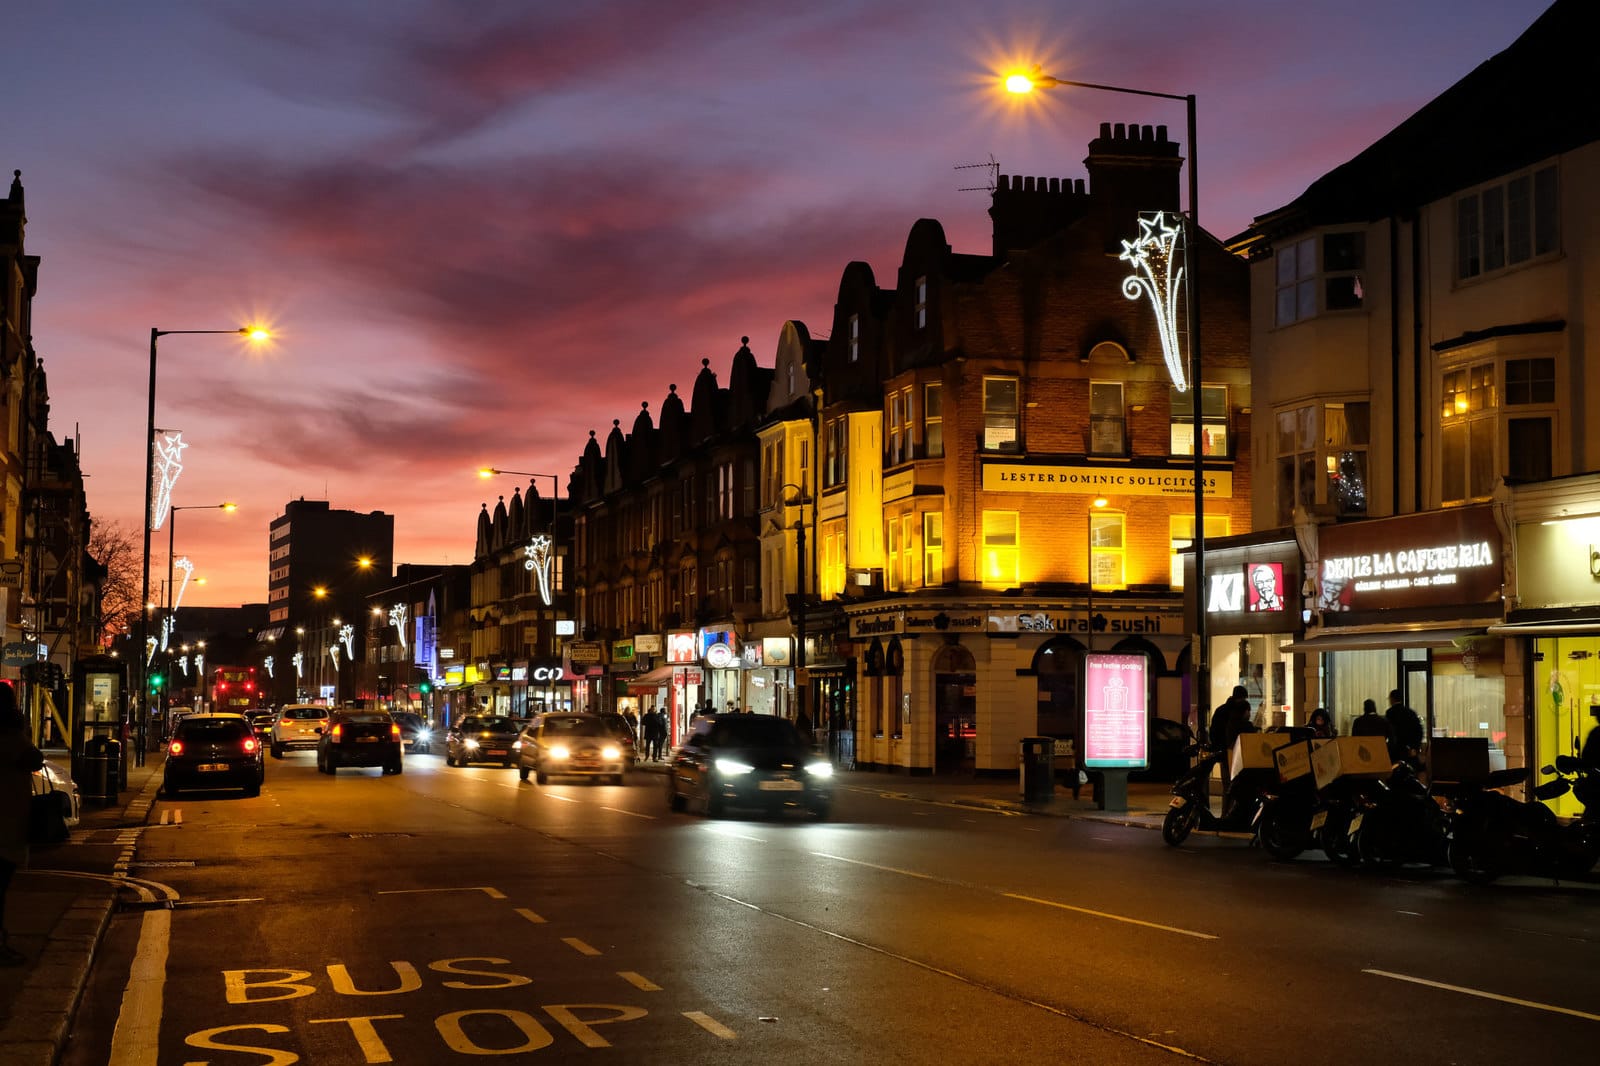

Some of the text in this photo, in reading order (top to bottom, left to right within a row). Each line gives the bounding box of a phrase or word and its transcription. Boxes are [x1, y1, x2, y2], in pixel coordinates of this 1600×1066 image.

[1001, 472, 1055, 482] LESTER
[1059, 474, 1124, 484] DOMINIC
[1373, 553, 1395, 576] LA
[1397, 541, 1493, 574] CAFETERIA
[952, 616, 981, 627] sushi
[1018, 613, 1160, 633] Sakura sushi
[222, 957, 533, 1005] BUS
[184, 1003, 649, 1066] STOP
